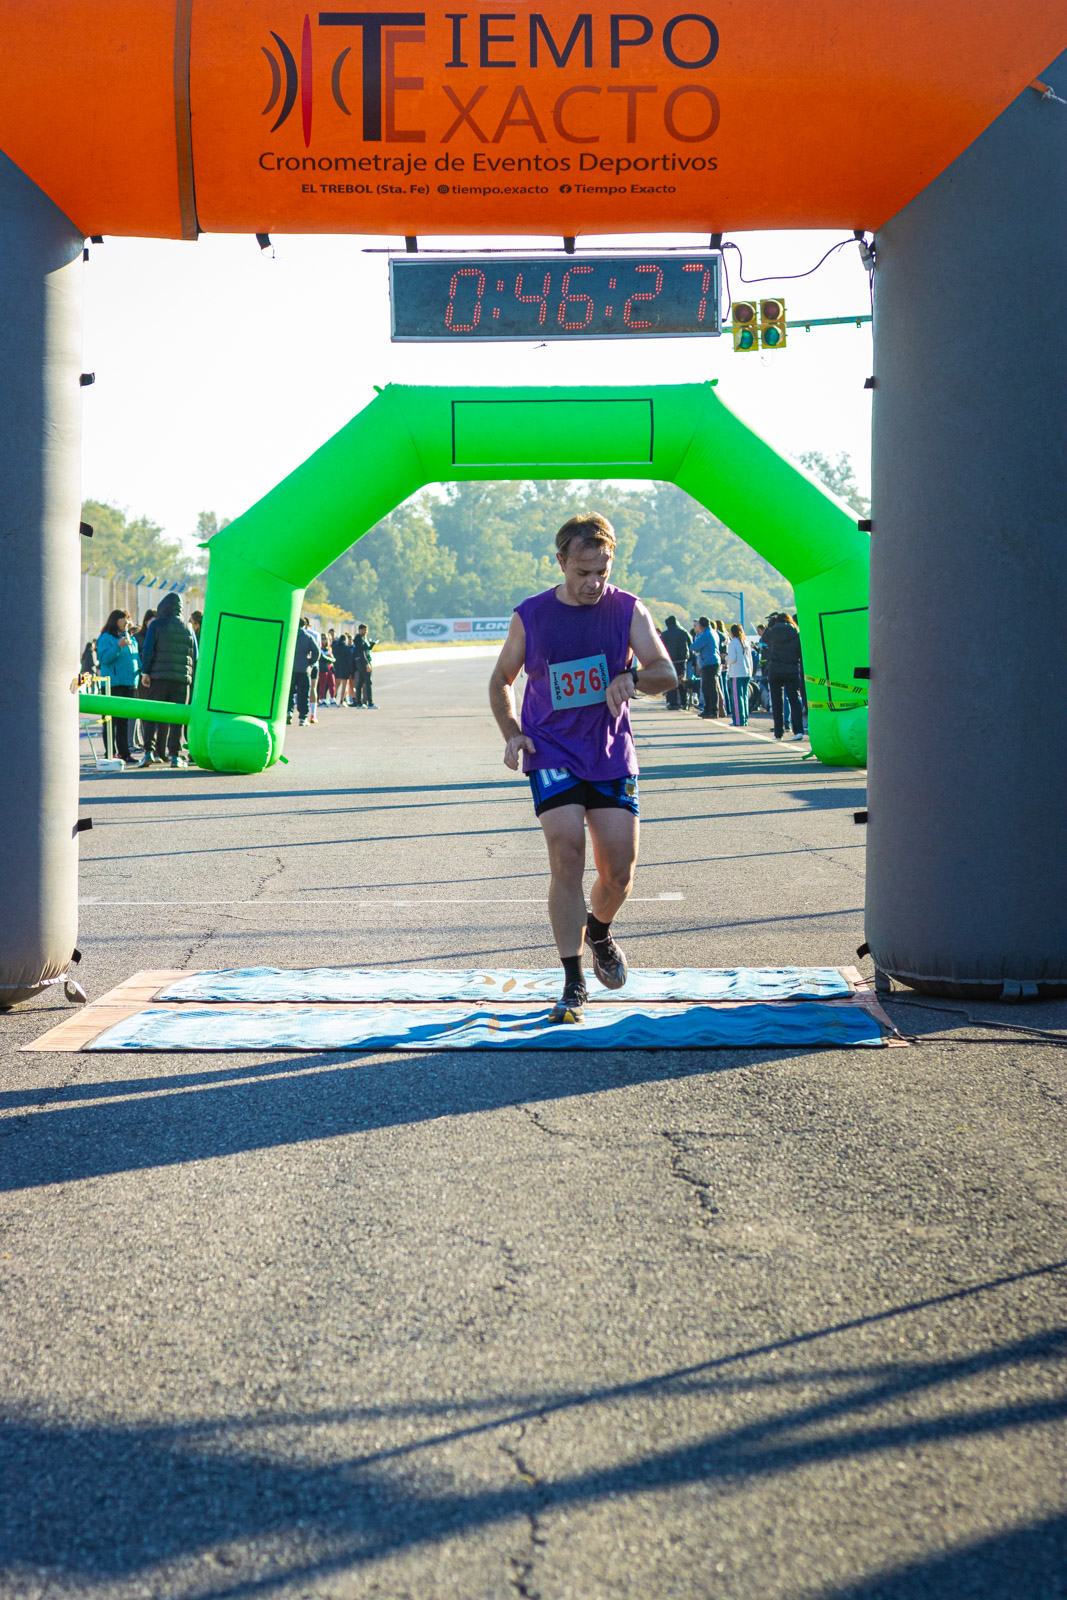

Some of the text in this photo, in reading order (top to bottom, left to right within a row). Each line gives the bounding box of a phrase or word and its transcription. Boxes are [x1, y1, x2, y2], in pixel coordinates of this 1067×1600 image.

[259, 152, 718, 175] Cronometraje de Eventos Deportivos
[302, 184, 676, 196] EL TREBOL (Sta. Fe) tiempo.exacto Tiempo Exacto
[417, 624, 441, 635] Ford
[561, 667, 602, 697] 376
